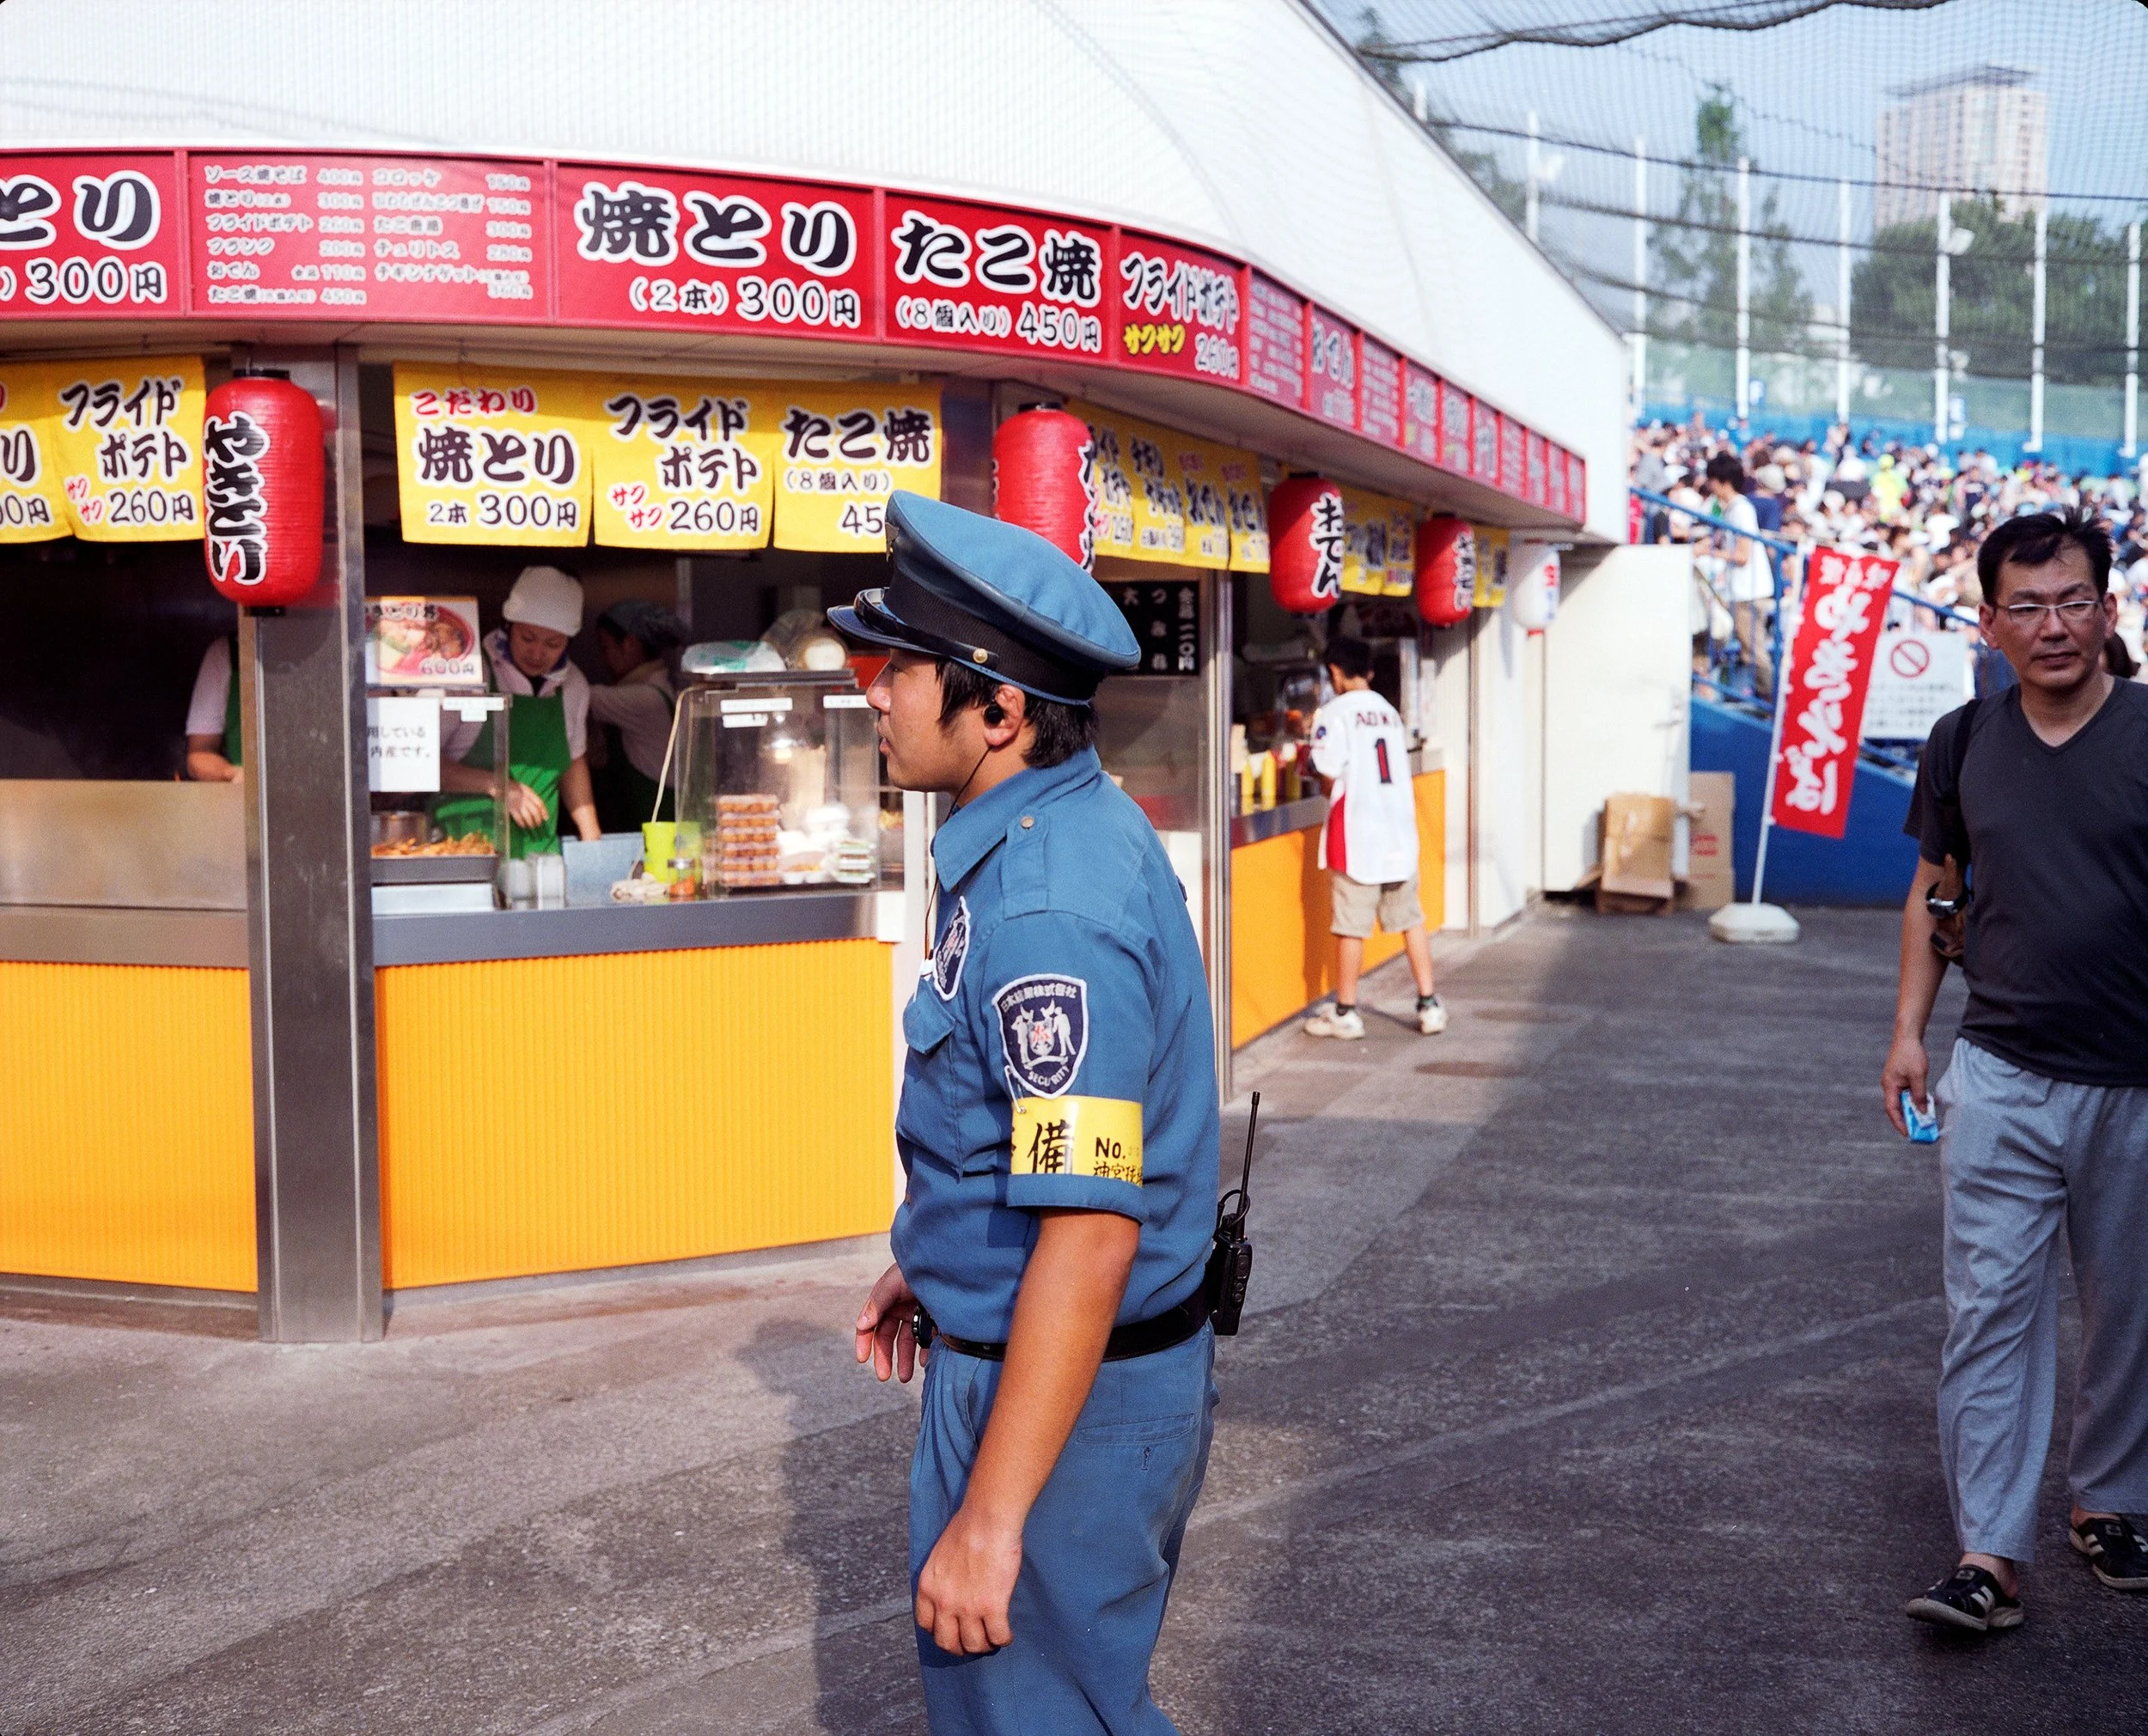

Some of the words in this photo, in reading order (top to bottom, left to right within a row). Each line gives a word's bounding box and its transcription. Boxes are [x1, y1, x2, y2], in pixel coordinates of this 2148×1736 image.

[207, 214, 312, 231] フライドポテト
[582, 188, 850, 269] 焼とり
[208, 238, 273, 254] フランク
[898, 217, 1097, 301] たこ焼
[741, 281, 857, 323] 300円
[1123, 255, 1238, 332] フライドポテト
[1019, 304, 1100, 349] 450円
[1124, 323, 1186, 355] サクサク
[61, 379, 183, 427] フライド
[413, 387, 537, 416] こだわり
[607, 393, 748, 443] フライド
[783, 408, 932, 463] たこ焼
[100, 430, 187, 478] ポテト
[418, 425, 577, 485] 焼とり
[661, 445, 759, 491] ポテト
[204, 415, 265, 582] やきとり
[611, 484, 646, 507] サク
[786, 470, 891, 492] (8個入り)
[0, 493, 51, 525] 0円
[109, 490, 195, 524] 260円
[429, 503, 468, 525] 2本
[479, 494, 577, 529] 300円
[629, 506, 664, 529] サク
[669, 499, 760, 533] 260円
[841, 503, 886, 535] 45
[1375, 737, 1393, 784] 1
[1028, 1066, 1071, 1087] SECURITY
[1012, 1118, 1073, 1174] 備
[1095, 1136, 1126, 1160] No.
[1093, 1160, 1144, 1185] 神宮球
